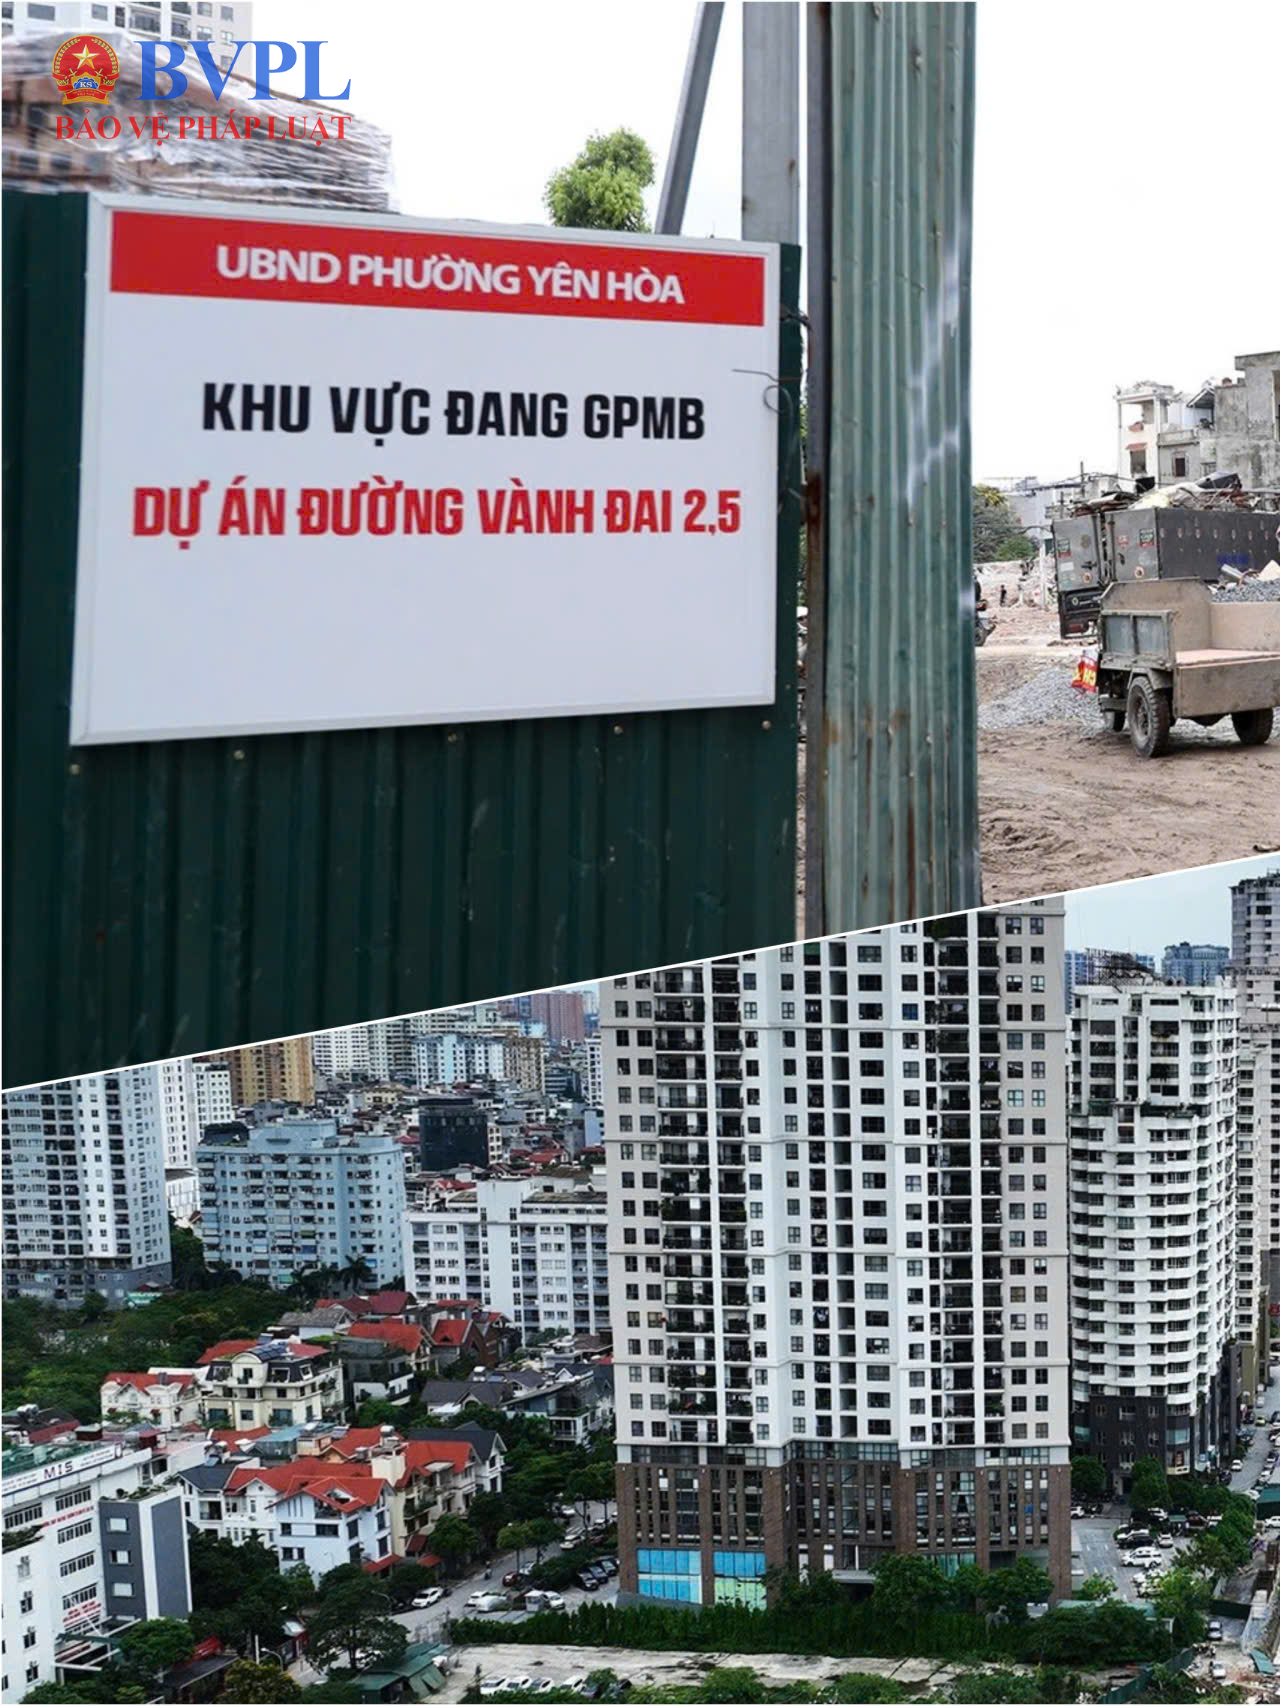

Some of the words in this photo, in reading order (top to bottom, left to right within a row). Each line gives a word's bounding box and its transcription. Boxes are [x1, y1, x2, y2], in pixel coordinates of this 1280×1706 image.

[217, 246, 341, 284] UBND
[350, 253, 519, 294] PHƯỜNG
[527, 261, 599, 300] YÊN
[607, 266, 685, 305] HÒA
[203, 382, 311, 433] KHU
[329, 381, 431, 447] VỰC
[444, 390, 568, 439] ĐANG
[584, 394, 705, 440] GPMB
[133, 480, 211, 550] DỰ
[218, 475, 286, 536] ÁN
[296, 475, 464, 536] ĐƯỜNG
[477, 477, 595, 534] VÀNH
[603, 489, 672, 533] ĐAI
[683, 489, 741, 536] 2,5
[44, 1460, 73, 1479] MIS
